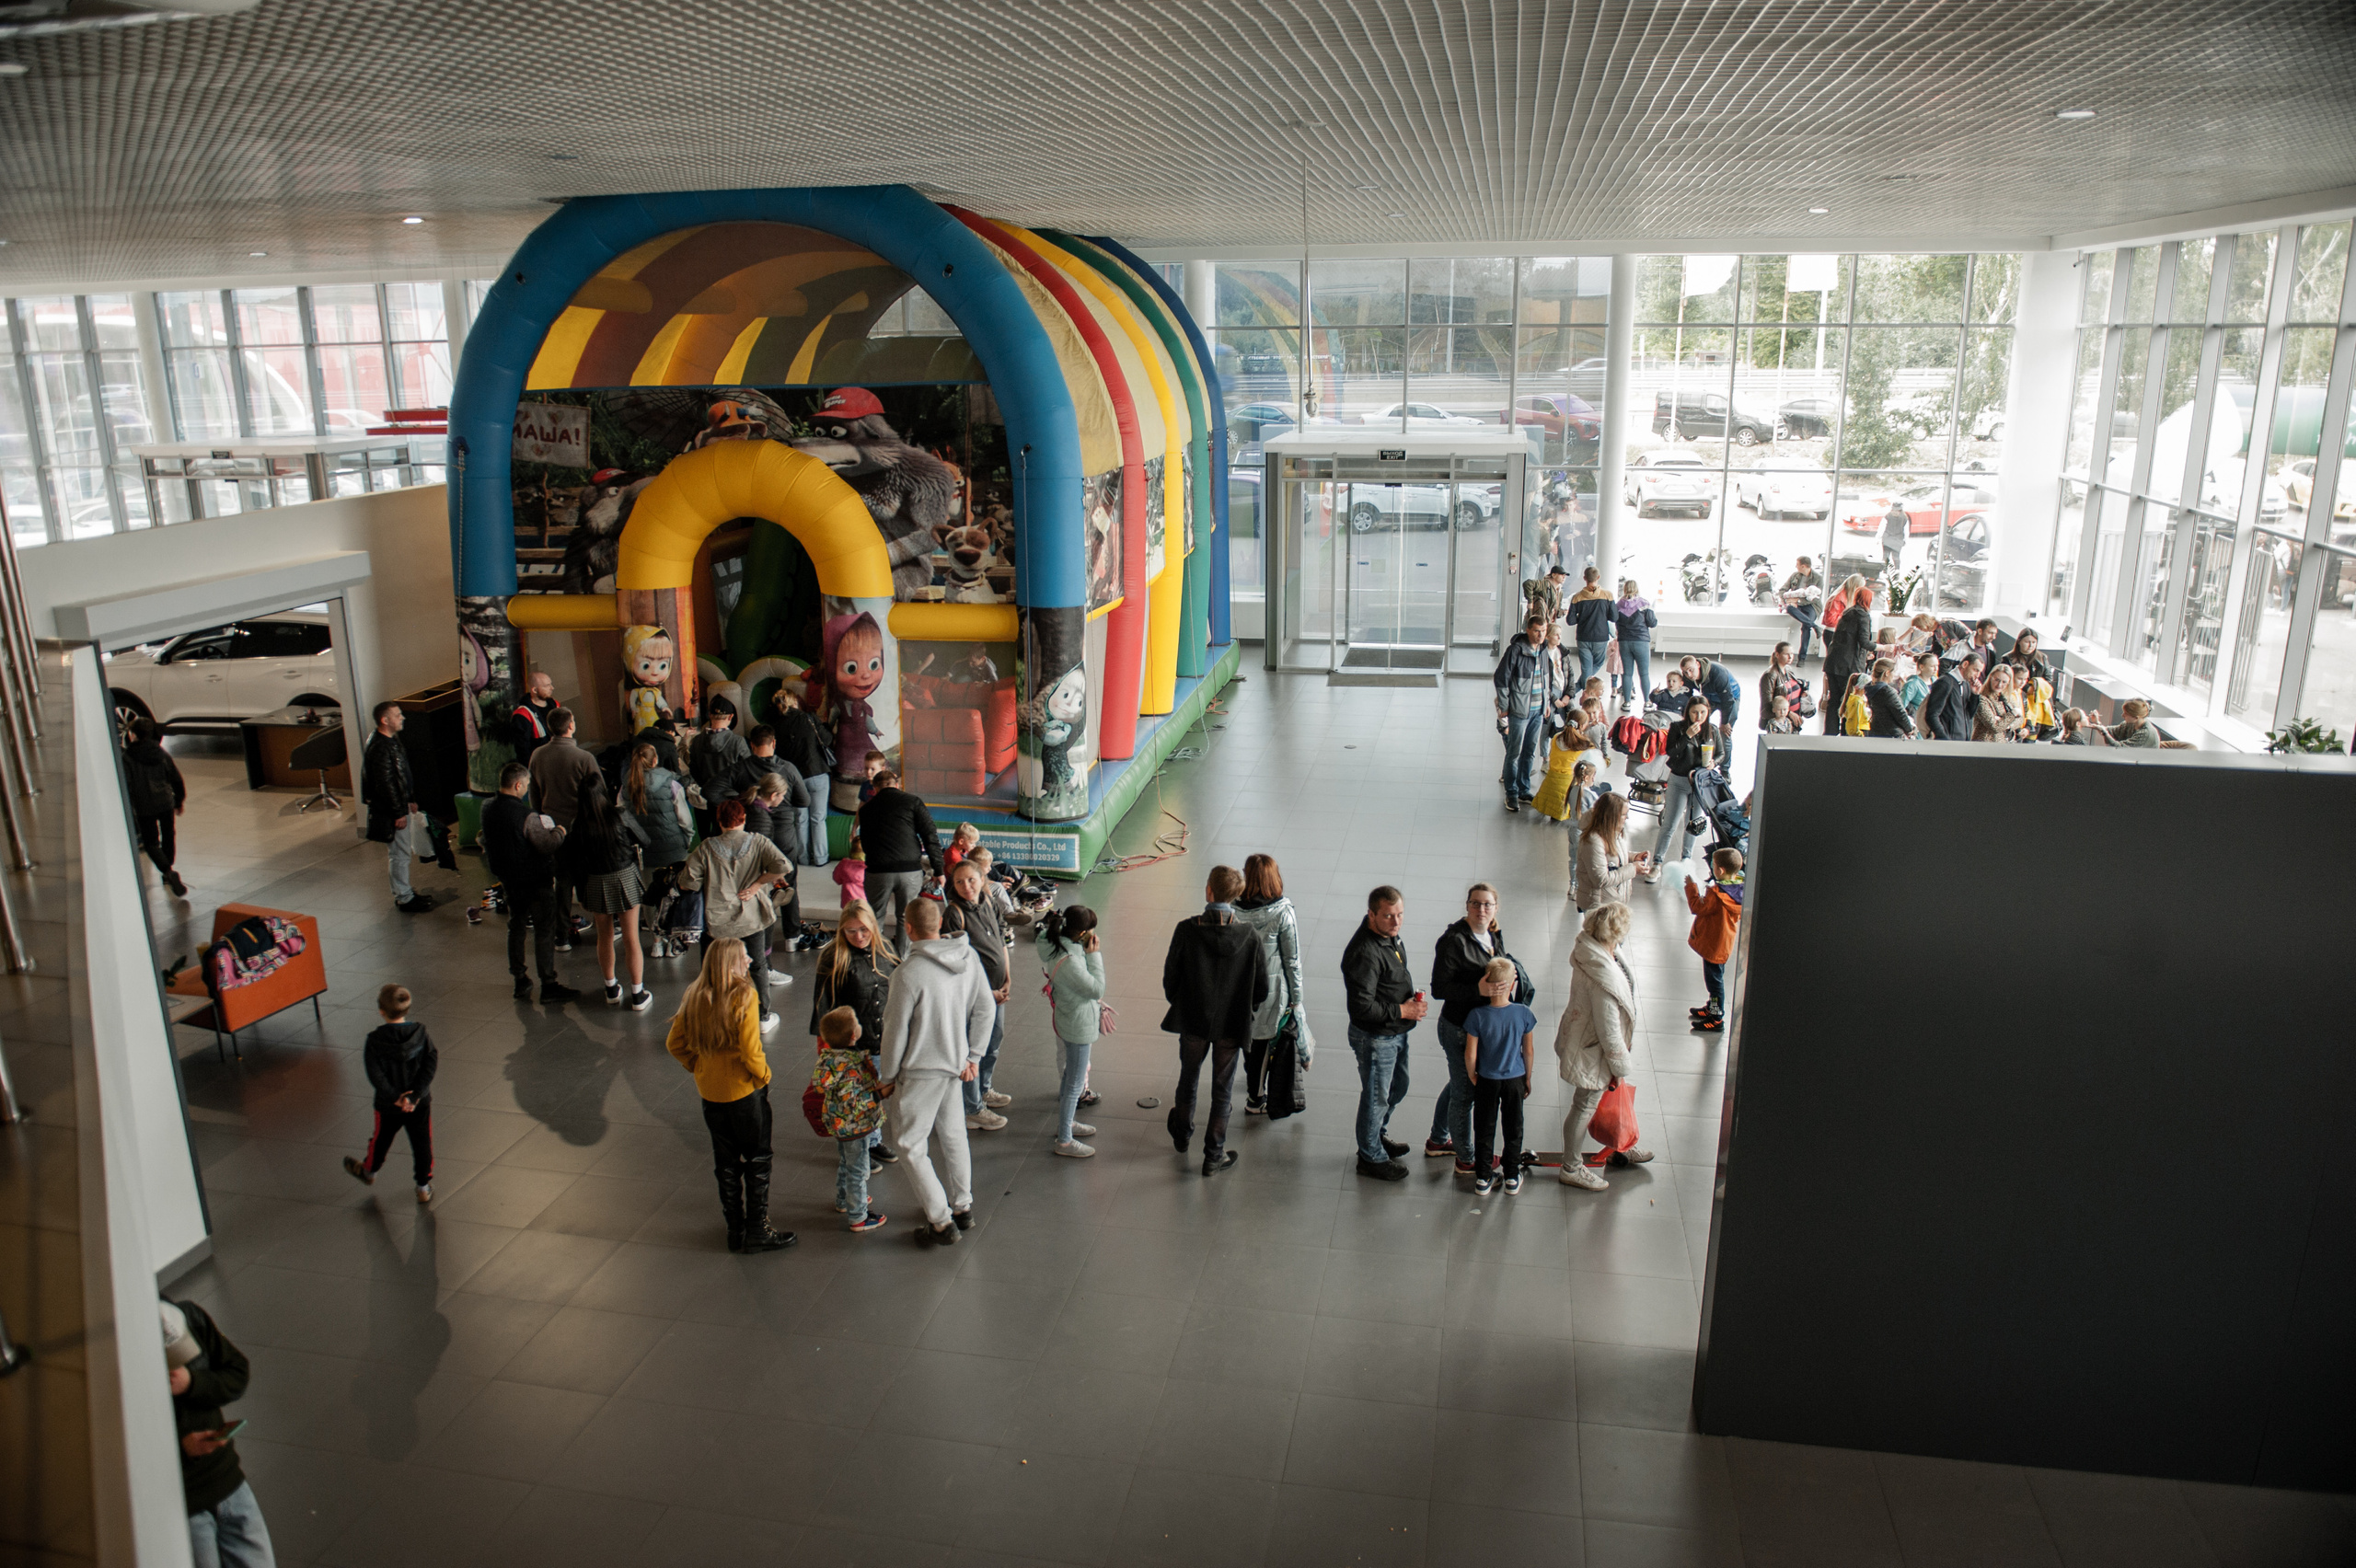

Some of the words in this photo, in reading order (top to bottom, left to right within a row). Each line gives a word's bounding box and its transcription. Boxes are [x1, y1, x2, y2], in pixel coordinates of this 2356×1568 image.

[976, 839, 1001, 848] atable
[1002, 840, 1036, 850] Products
[1053, 842, 1067, 851] Ltd
[998, 851, 1011, 859] +86
